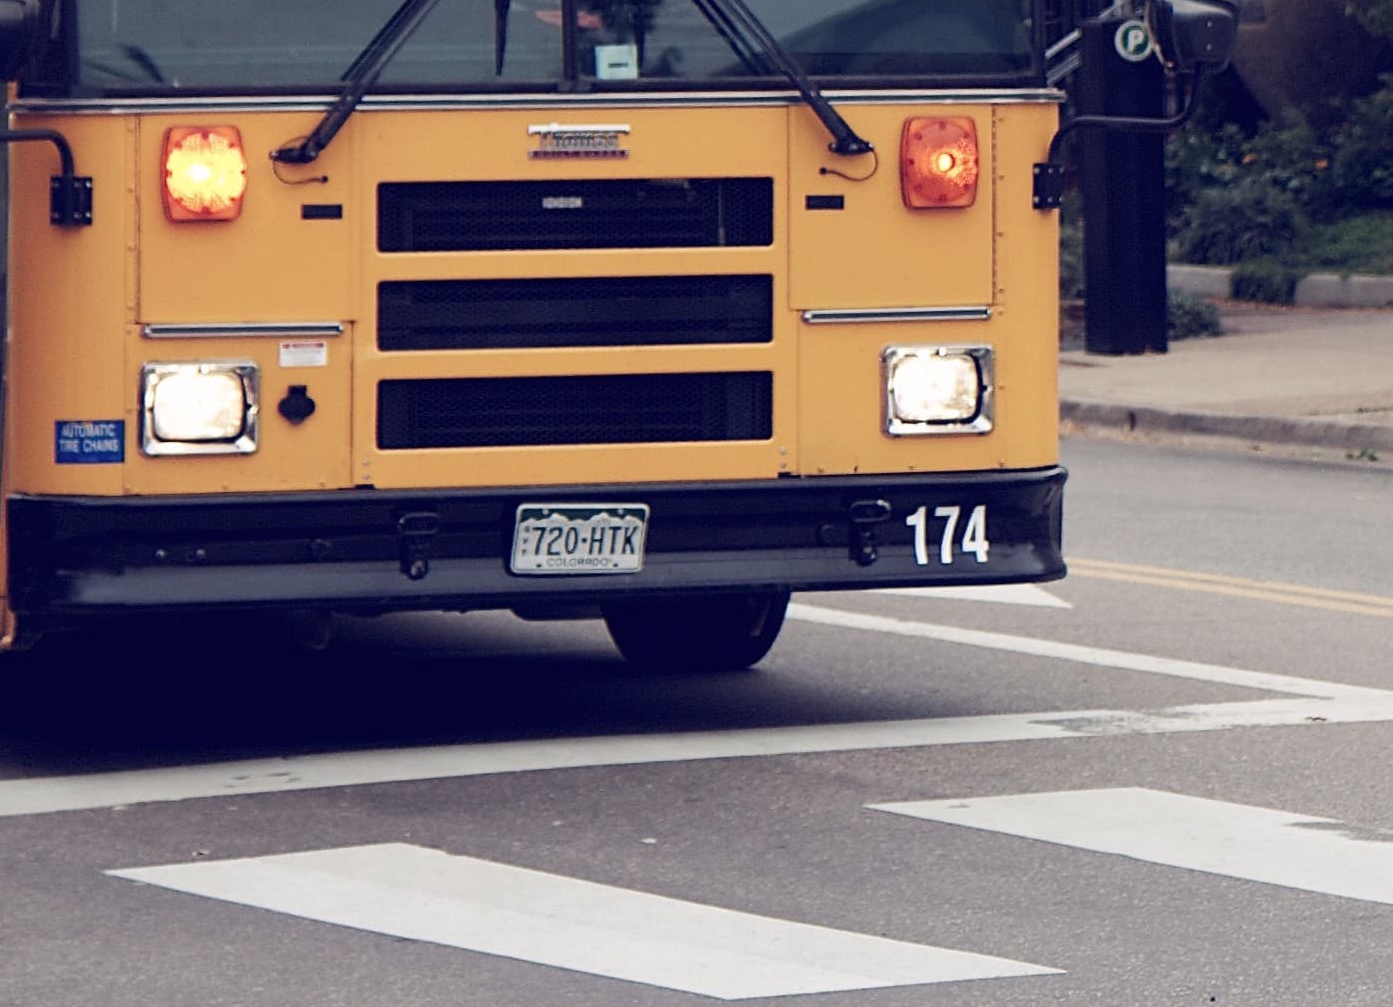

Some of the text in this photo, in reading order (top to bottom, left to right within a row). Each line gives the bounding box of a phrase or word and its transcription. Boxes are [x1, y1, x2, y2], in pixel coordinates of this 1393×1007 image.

[1126, 29, 1145, 54] P
[61, 423, 116, 437] AUTOMATIC
[83, 439, 119, 453] CHAINS
[905, 505, 990, 565] 174
[547, 557, 611, 567] COLORADO
